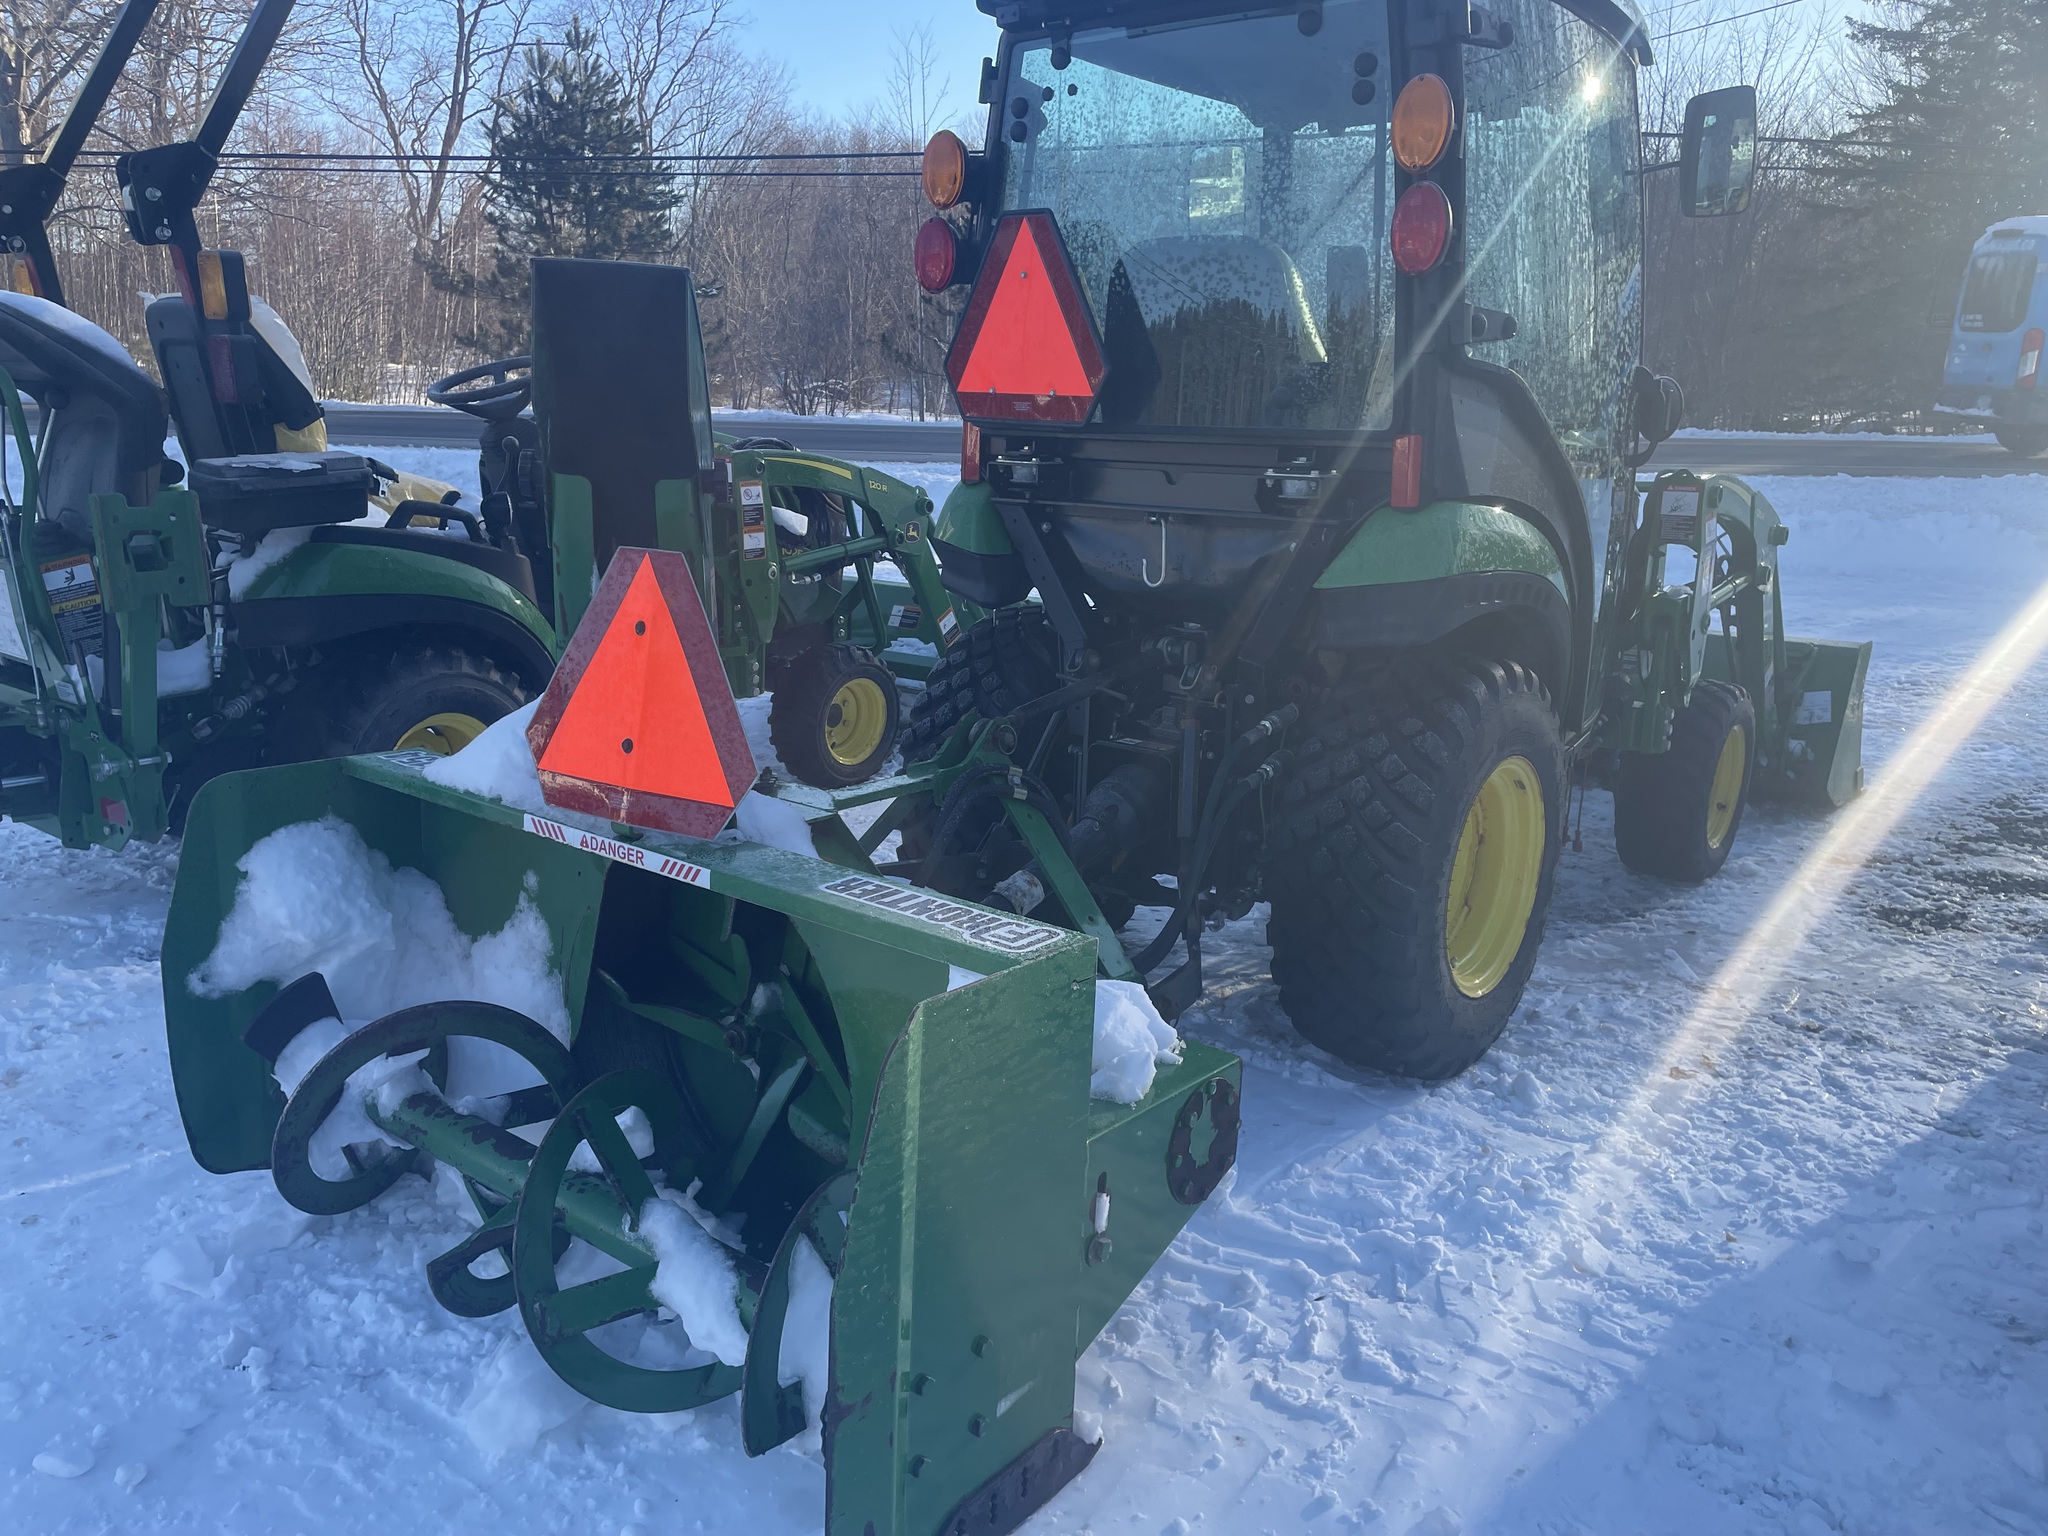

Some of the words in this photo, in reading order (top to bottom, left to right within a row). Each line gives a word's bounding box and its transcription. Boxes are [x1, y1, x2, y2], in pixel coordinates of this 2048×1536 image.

[868, 480, 882, 491] 120
[50, 557, 86, 570] WARNING
[65, 598, 97, 611] CAUTION
[590, 836, 645, 867] DANGER
[823, 877, 1062, 951] FRONTIER
